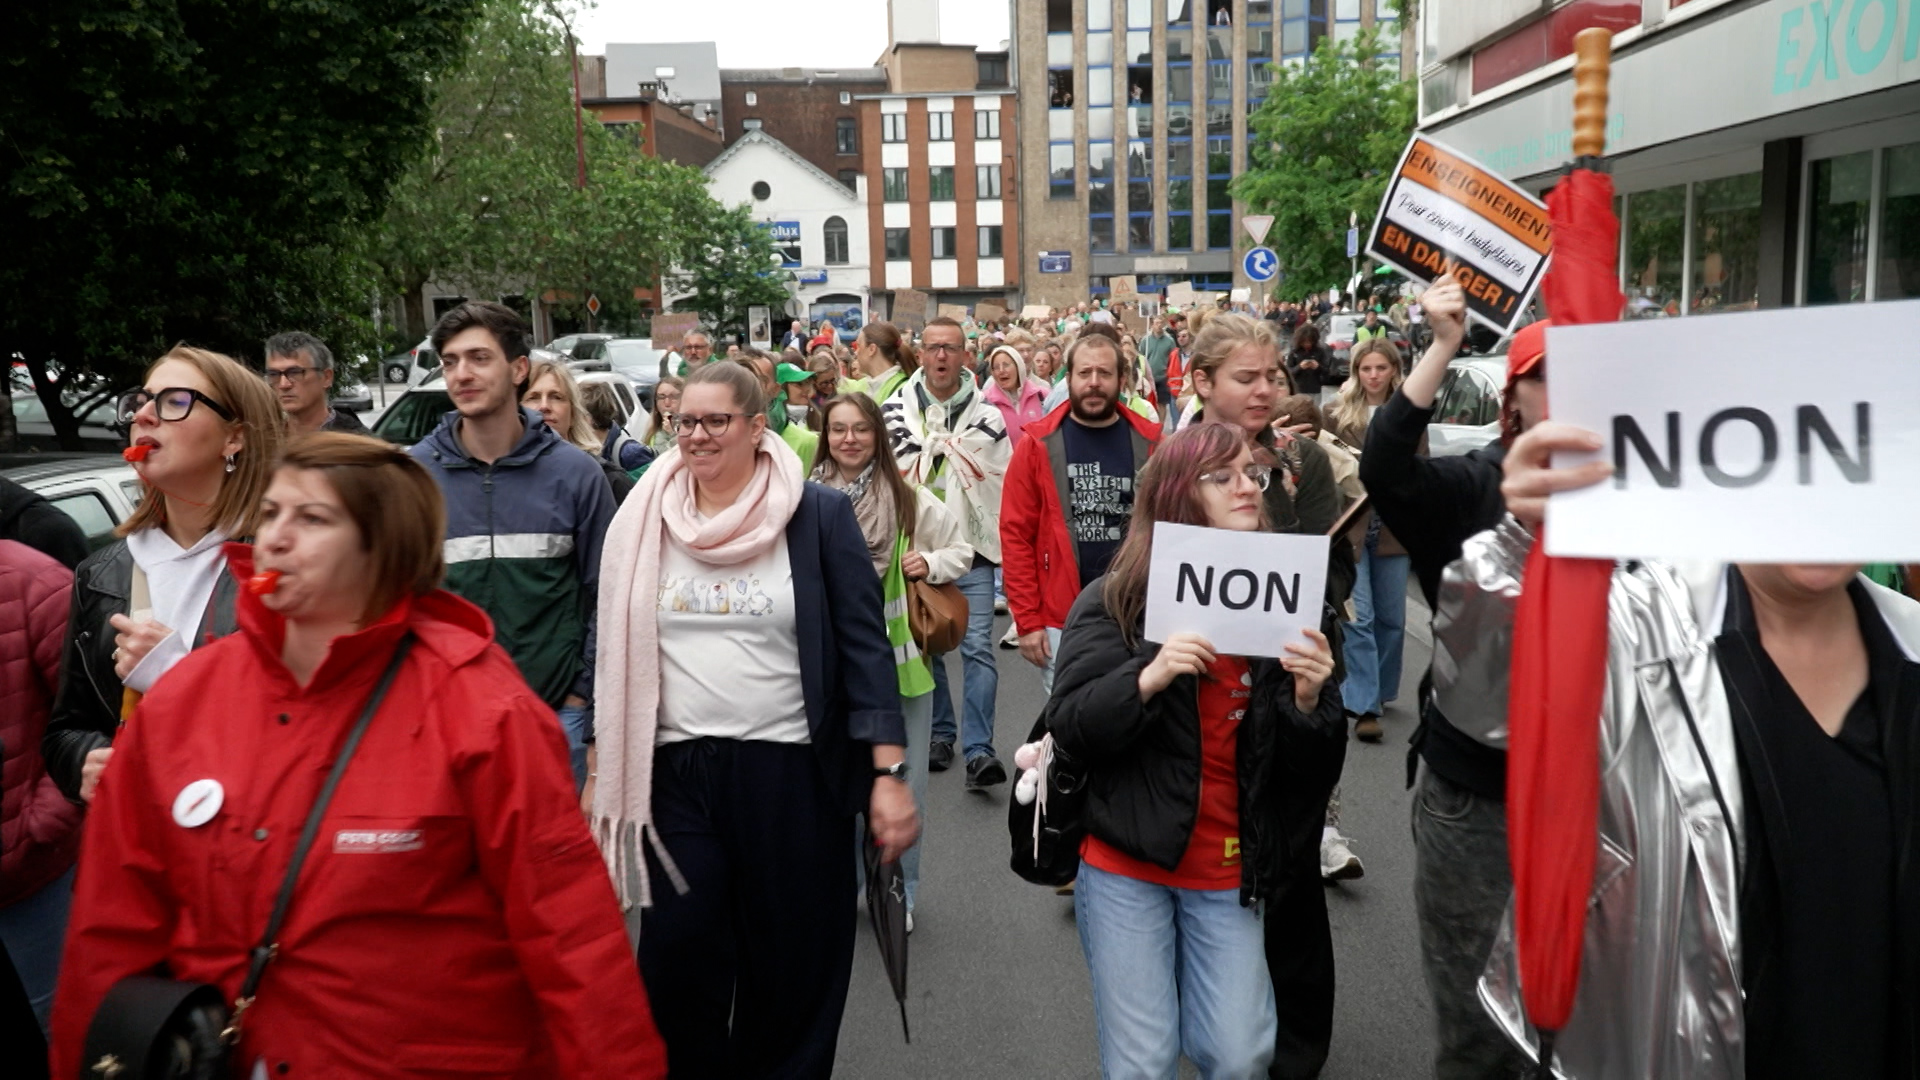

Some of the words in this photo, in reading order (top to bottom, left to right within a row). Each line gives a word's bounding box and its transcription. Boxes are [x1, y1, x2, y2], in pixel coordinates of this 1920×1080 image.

[1522, 136, 1541, 165] de
[1408, 150, 1552, 241] ENSEIGNEMENT
[1381, 224, 1412, 254] EN
[1411, 241, 1503, 306] DANGER
[1612, 400, 1872, 490] NON
[1073, 462, 1099, 477] THE
[1074, 475, 1123, 491] SYSTEM
[1075, 489, 1116, 504] WORKS
[1075, 514, 1105, 527] YOU
[1076, 527, 1112, 541] WORK
[1176, 562, 1300, 614] NON
